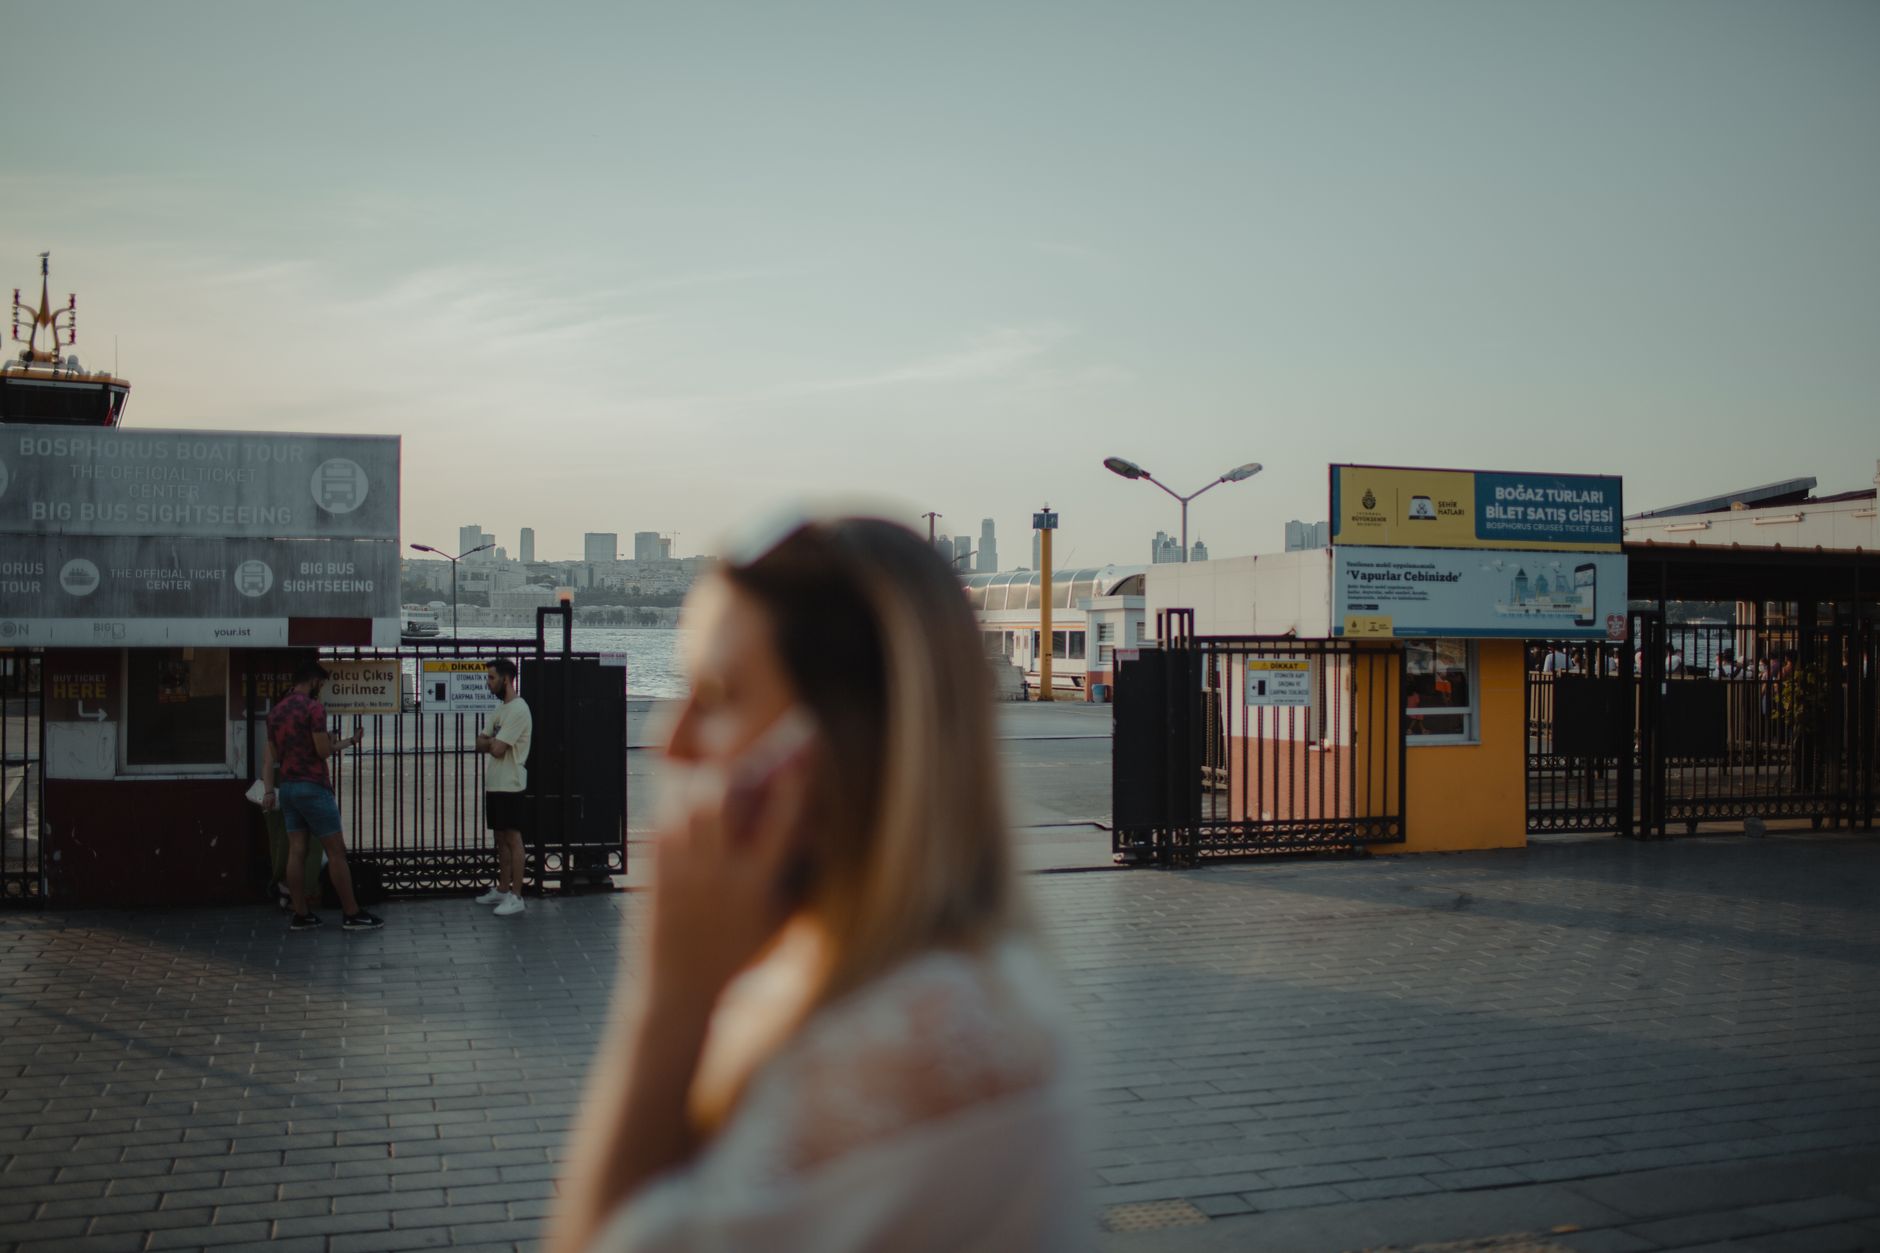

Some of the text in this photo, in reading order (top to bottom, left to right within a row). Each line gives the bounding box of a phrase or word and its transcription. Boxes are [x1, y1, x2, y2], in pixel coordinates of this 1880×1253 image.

[20, 437, 303, 463] BOSPHORUS BOAT TOUR
[70, 464, 256, 484] THE OFFICIAL TICKET
[129, 483, 198, 498] CENTER
[1495, 484, 1604, 503] BOĞAZ TURLARI
[32, 501, 292, 525] BIG BUS SIGHTSEEING
[1438, 508, 1465, 516] HATLARI
[1486, 502, 1614, 525] BİLET SATIŞ GİŞESİ
[1486, 522, 1614, 533] BOSPHORUS CRUISES TICKET SALES
[0, 562, 44, 575] ORUS
[110, 568, 227, 580] THE OFFICIAL TICKET
[300, 562, 354, 575] BIG BUS
[0, 580, 41, 593] TOUR
[146, 580, 191, 591] CENTER
[283, 580, 375, 593] SIGHTSEEING
[214, 627, 251, 638] your.ist
[53, 674, 106, 682] BUY TICKET
[242, 673, 260, 681] BY
[363, 669, 394, 682] Çıkış
[53, 682, 107, 699] HERE
[332, 683, 386, 696] Girilmez
